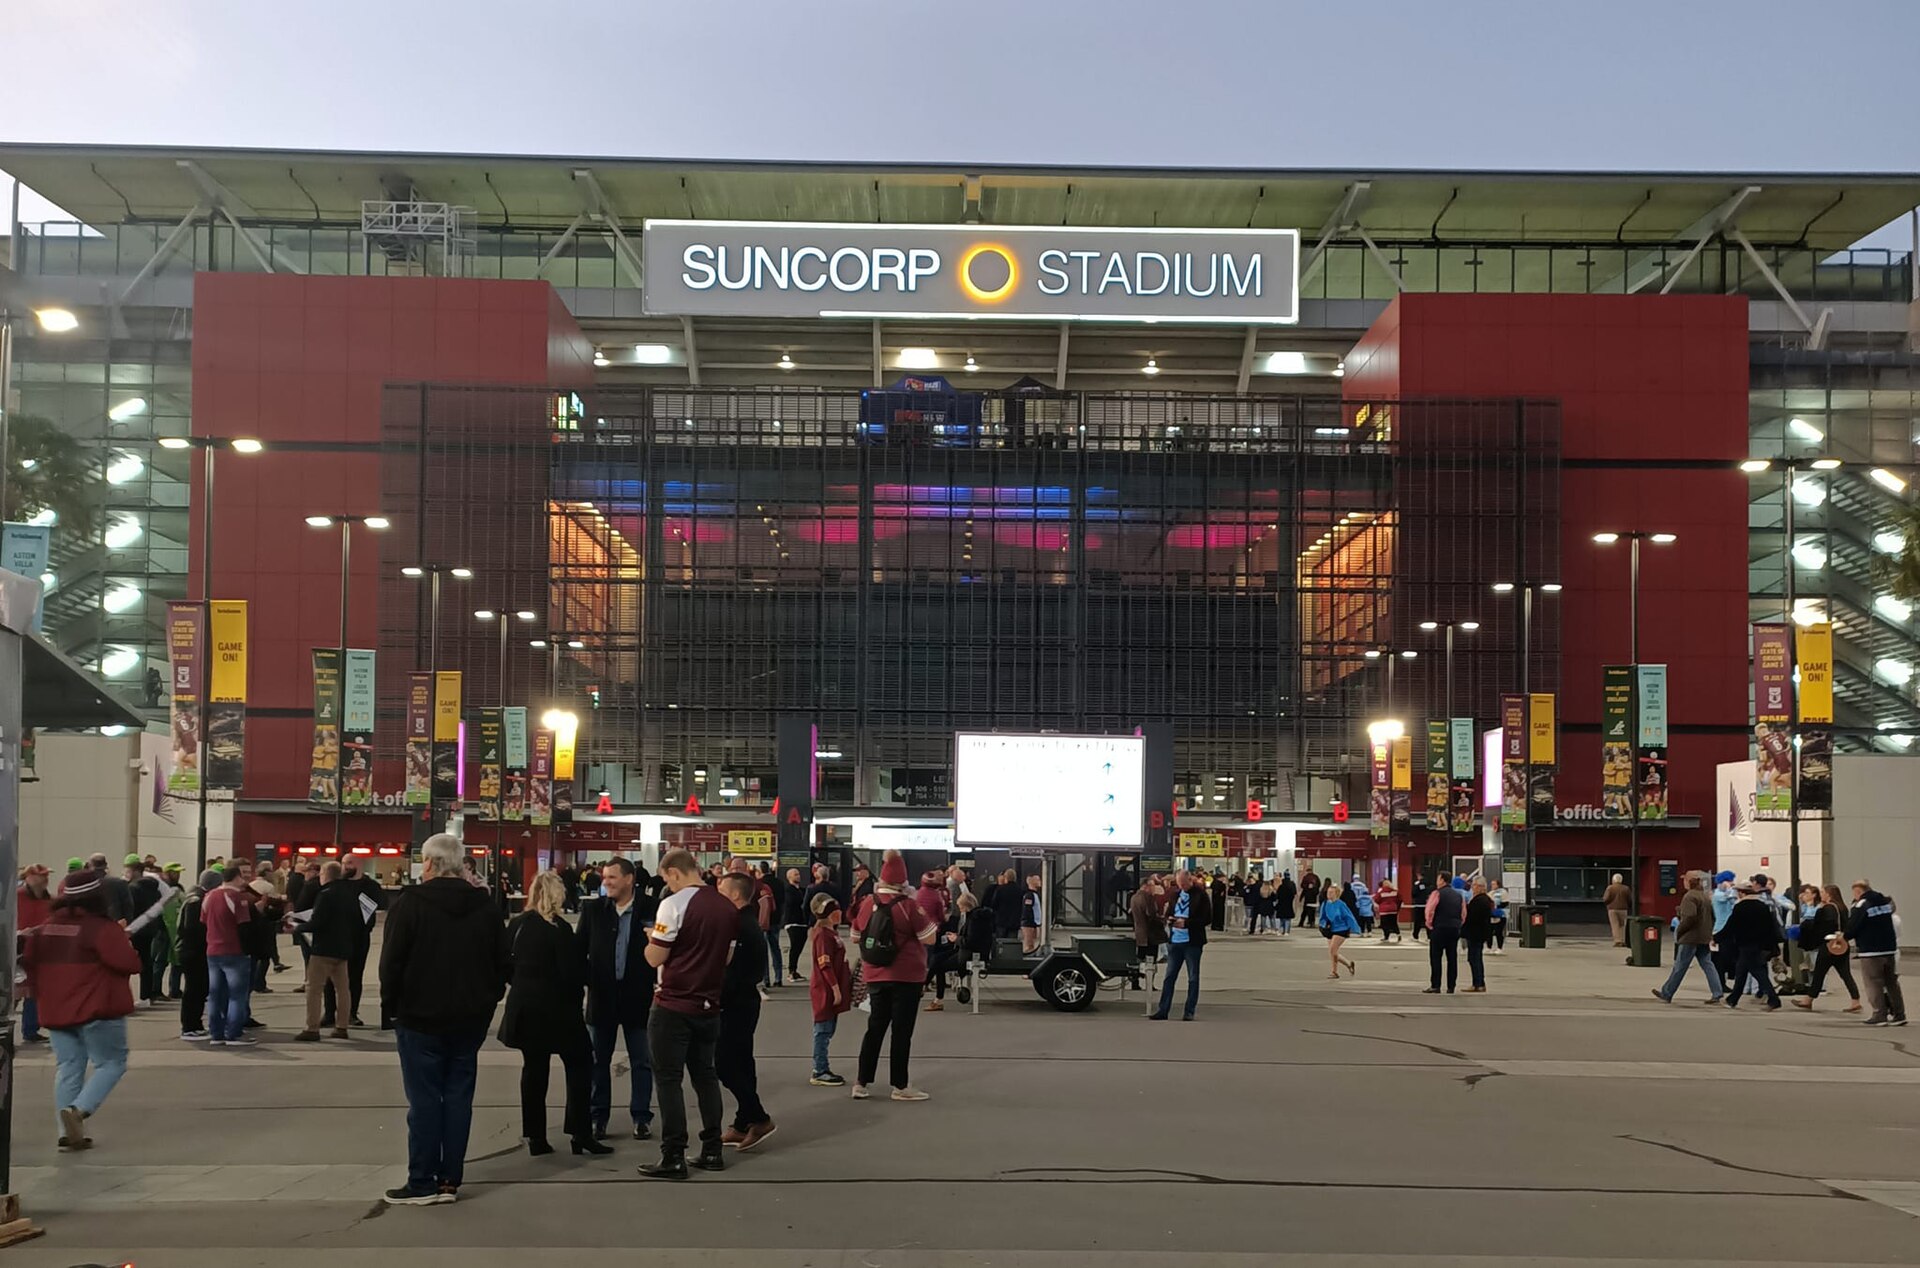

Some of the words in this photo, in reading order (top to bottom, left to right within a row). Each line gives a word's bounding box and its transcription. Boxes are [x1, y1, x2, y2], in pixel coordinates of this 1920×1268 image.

[682, 243, 941, 292] SUNCORP
[1037, 249, 1262, 297] STADIUM
[217, 642, 243, 651] GAME
[222, 652, 238, 662] ON!
[1803, 663, 1828, 671] GAME
[1808, 672, 1824, 682] ON!
[597, 796, 613, 815] A
[684, 795, 701, 815] A
[1247, 800, 1262, 821] B
[1334, 800, 1348, 822] B
[787, 807, 801, 824] A
[1151, 811, 1164, 828] B
